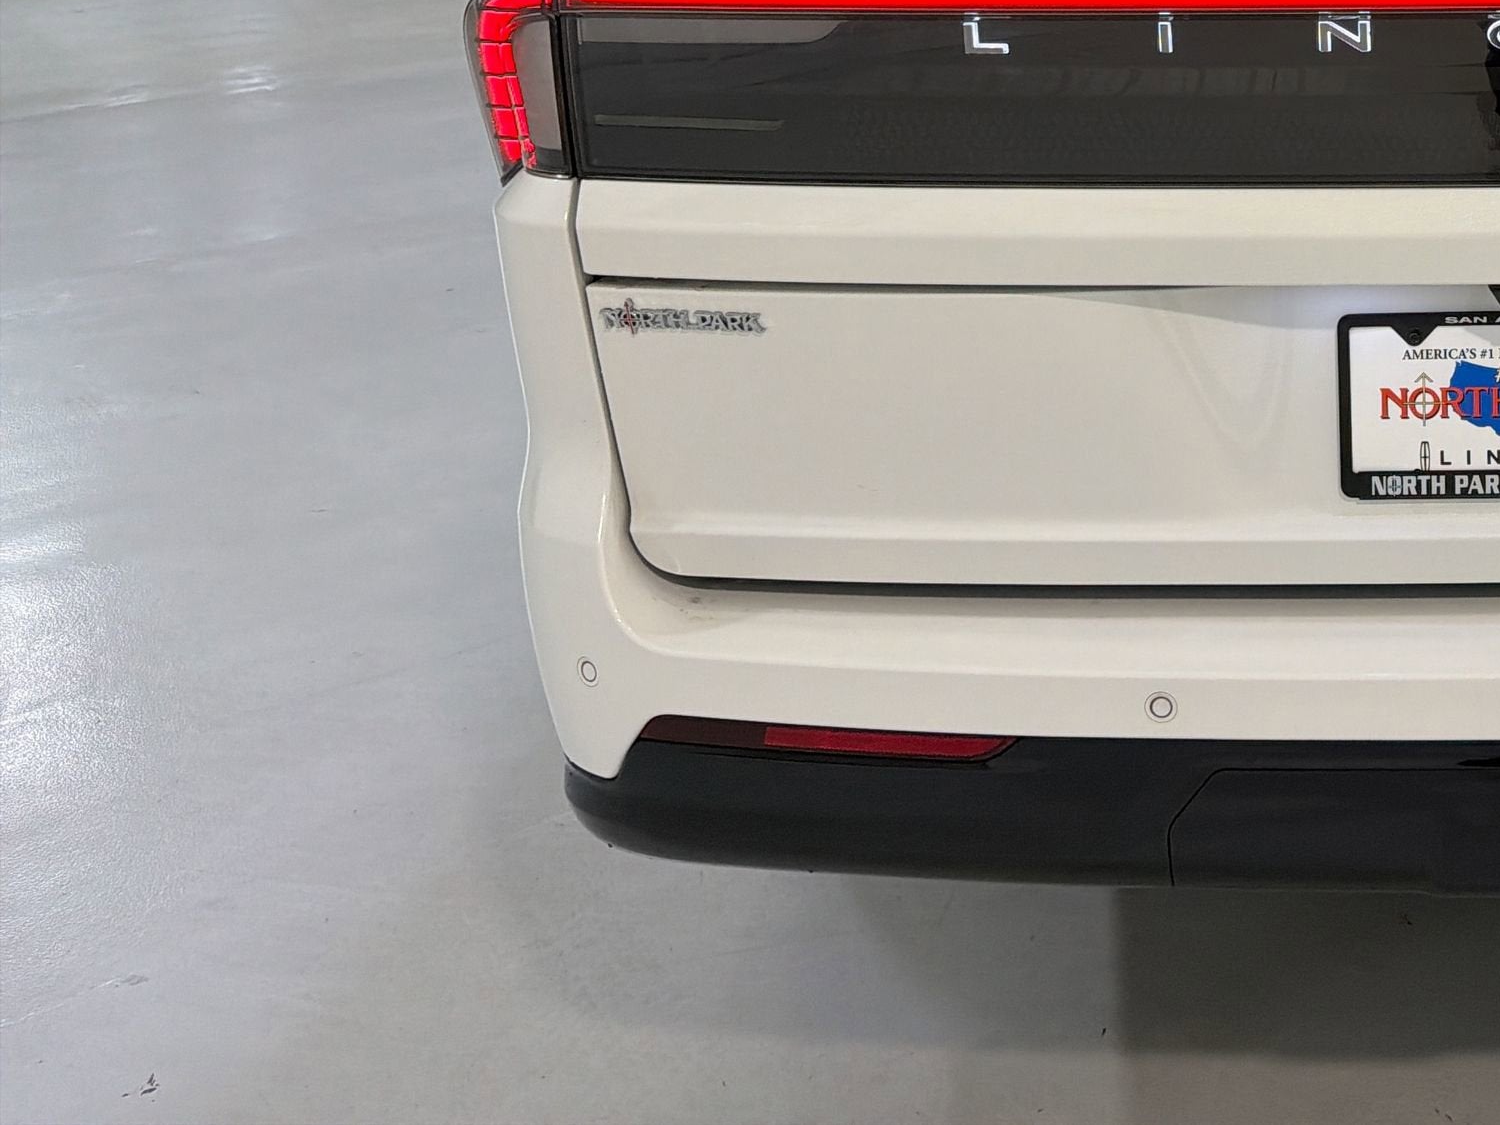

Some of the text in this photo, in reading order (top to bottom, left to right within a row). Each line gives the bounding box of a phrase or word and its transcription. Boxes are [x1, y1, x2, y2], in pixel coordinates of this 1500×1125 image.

[600, 307, 767, 334] NORTH PARK
[1444, 315, 1488, 324] SAN
[1402, 347, 1477, 361] AMERICA'S
[1479, 348, 1494, 360] #1
[1371, 474, 1446, 496] NORTH
